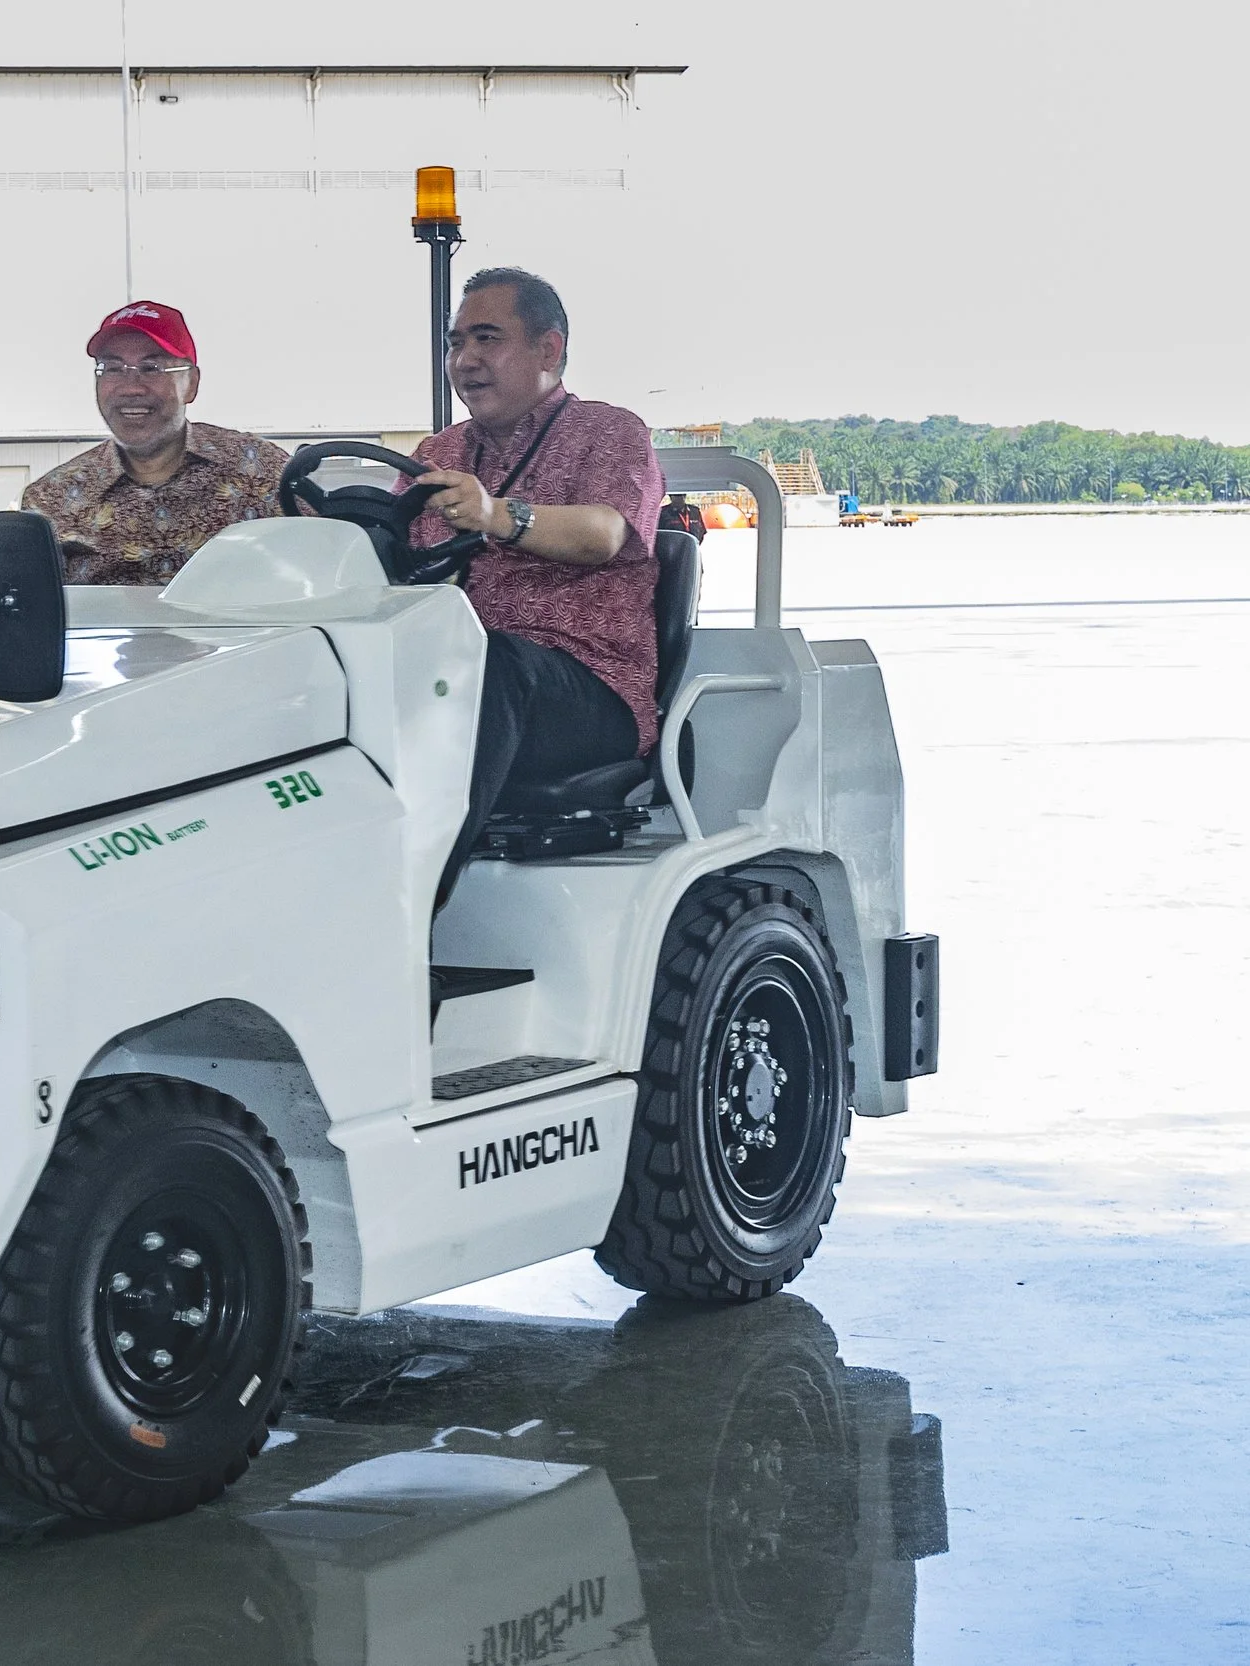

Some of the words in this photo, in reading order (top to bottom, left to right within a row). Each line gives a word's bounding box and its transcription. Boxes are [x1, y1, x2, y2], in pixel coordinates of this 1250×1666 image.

[265, 770, 324, 810] 320
[166, 818, 210, 843] BATTERY
[459, 1116, 600, 1190] HANGCHA
